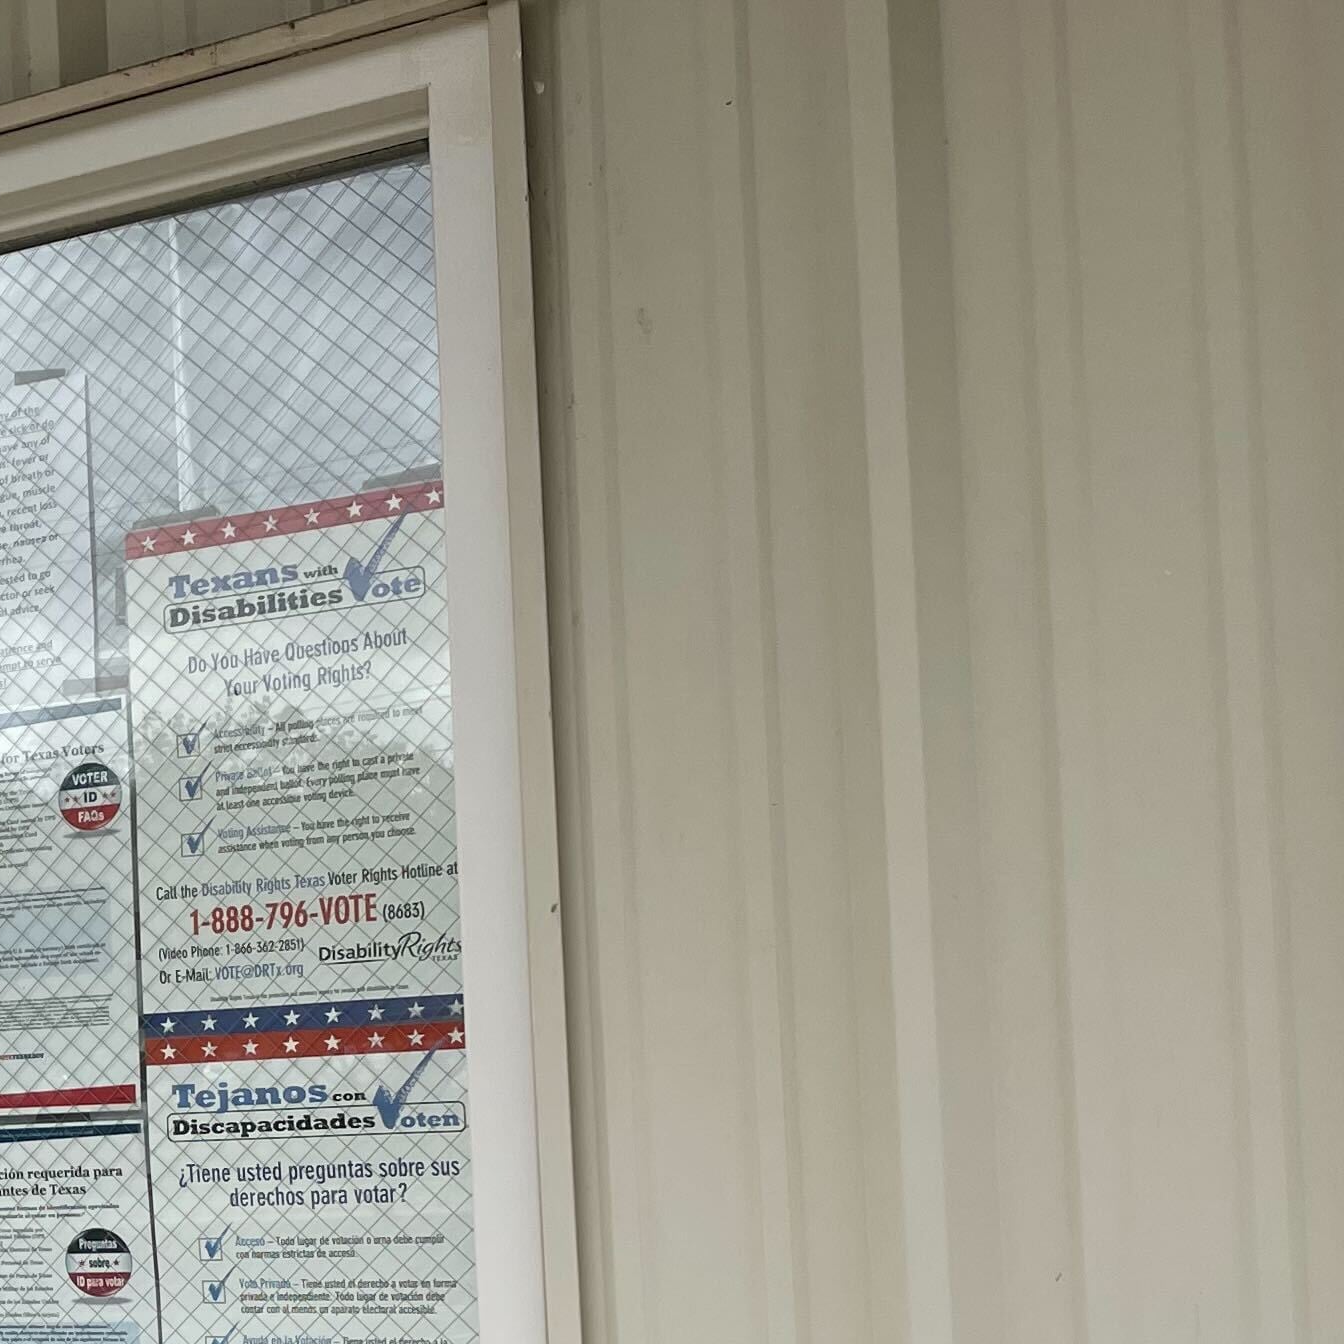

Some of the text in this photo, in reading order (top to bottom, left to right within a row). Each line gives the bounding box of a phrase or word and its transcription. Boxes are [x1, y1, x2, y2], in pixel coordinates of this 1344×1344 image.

[28, 572, 37, 580] to
[40, 571, 51, 580] go
[169, 563, 338, 599] Texans with
[22, 591, 32, 599] or
[35, 585, 55, 595] seek
[169, 587, 343, 627] Disabilities
[188, 628, 407, 674] Do You Have Questions About
[224, 661, 371, 696] Your Voting Rights?
[1, 752, 19, 765] for
[22, 749, 59, 761] Texas
[62, 744, 104, 757] Voters
[72, 771, 107, 785] VOTER
[84, 792, 97, 803] ID
[78, 810, 104, 822] FAQs
[156, 862, 458, 900] Call the Disability Rights Texas Voter Rights Hotline at
[190, 893, 425, 936] 1-888-796-VOTE (8683)
[159, 938, 304, 962] (Video Phone: 1-866-362-2851)
[160, 963, 304, 984] Or E-Mail: VOTE@DRTx.org
[172, 1082, 366, 1113] Tejanos con
[172, 1112, 375, 1137] Discapacidades
[27, 1166, 90, 1181] requerida
[93, 1167, 122, 1180] para
[179, 1157, 460, 1187] ¿Tiene usted preguntas sobre sus
[32, 1184, 47, 1195] de
[49, 1184, 87, 1195] Texas
[230, 1183, 407, 1209] derechos para votar?
[79, 1238, 117, 1251] Preguntas
[77, 1276, 124, 1290] ID para votar
